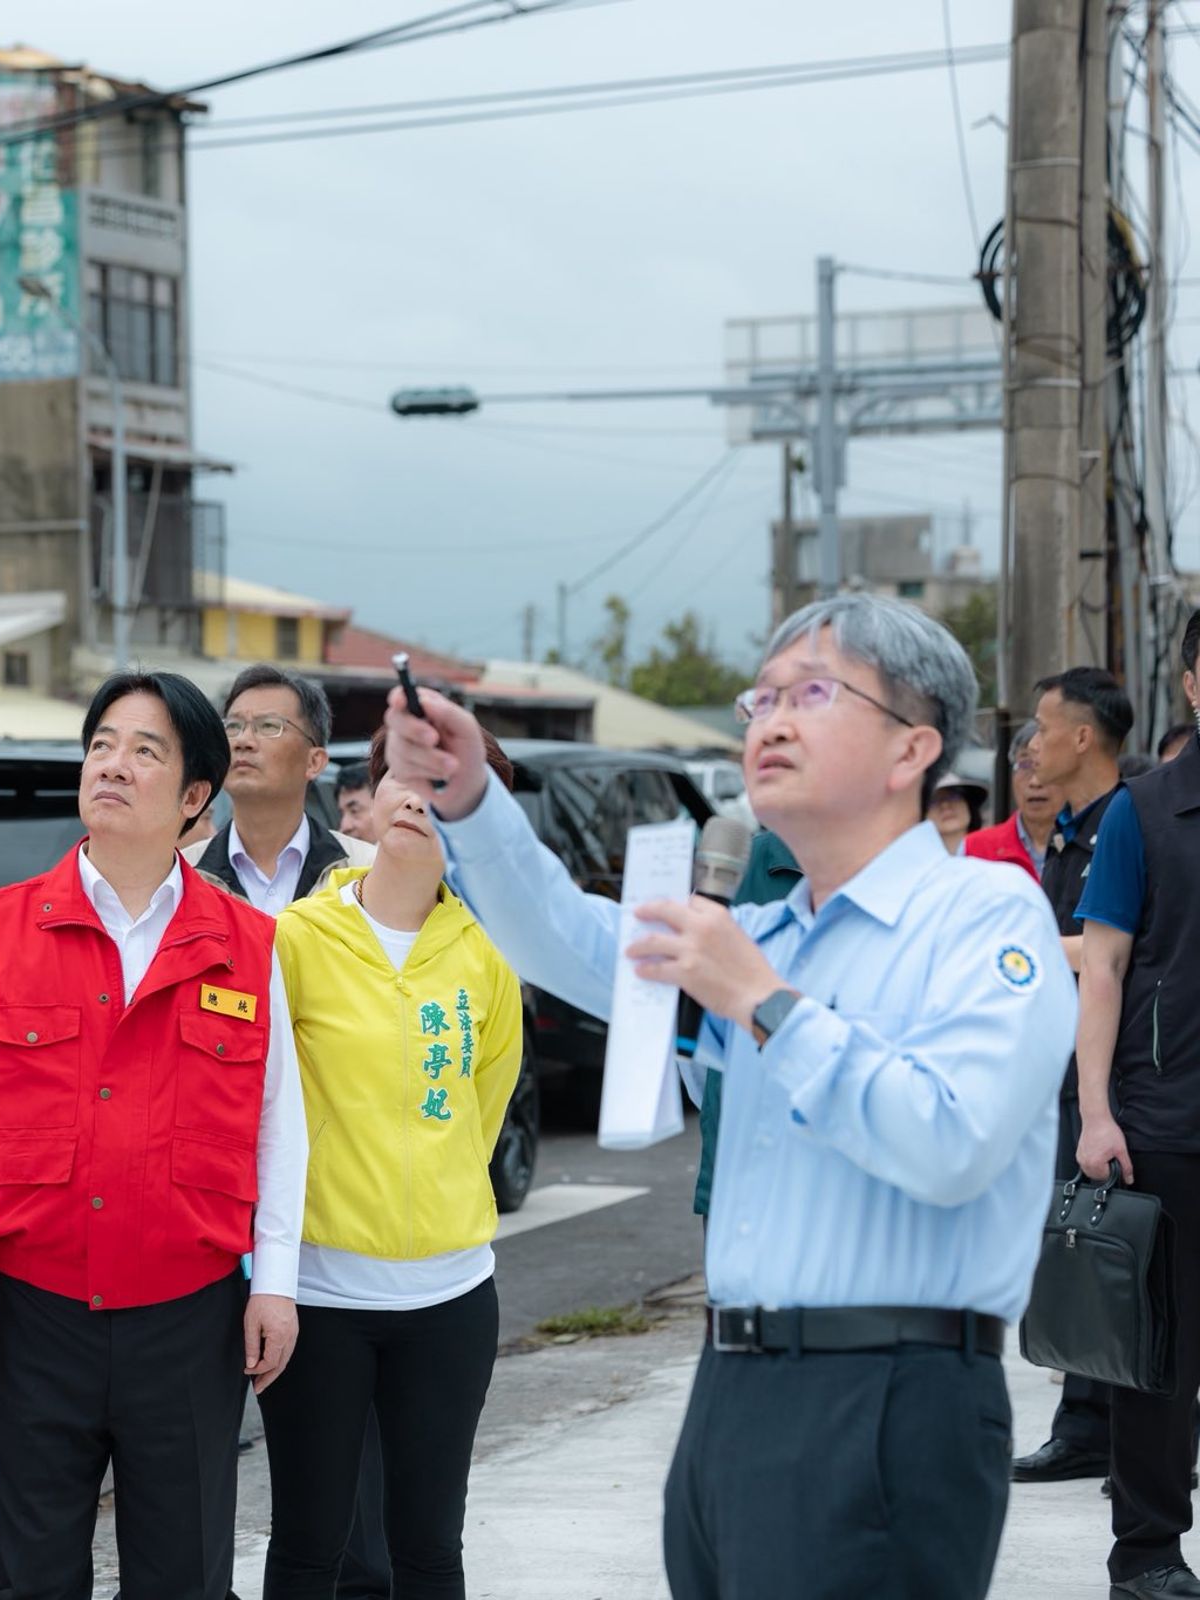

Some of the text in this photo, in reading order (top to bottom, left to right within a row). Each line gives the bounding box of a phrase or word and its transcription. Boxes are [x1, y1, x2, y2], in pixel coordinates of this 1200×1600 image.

[207, 992, 248, 1013] 總統
[455, 988, 475, 1079] 立法委員
[420, 1001, 452, 1121] 陳亭妃
